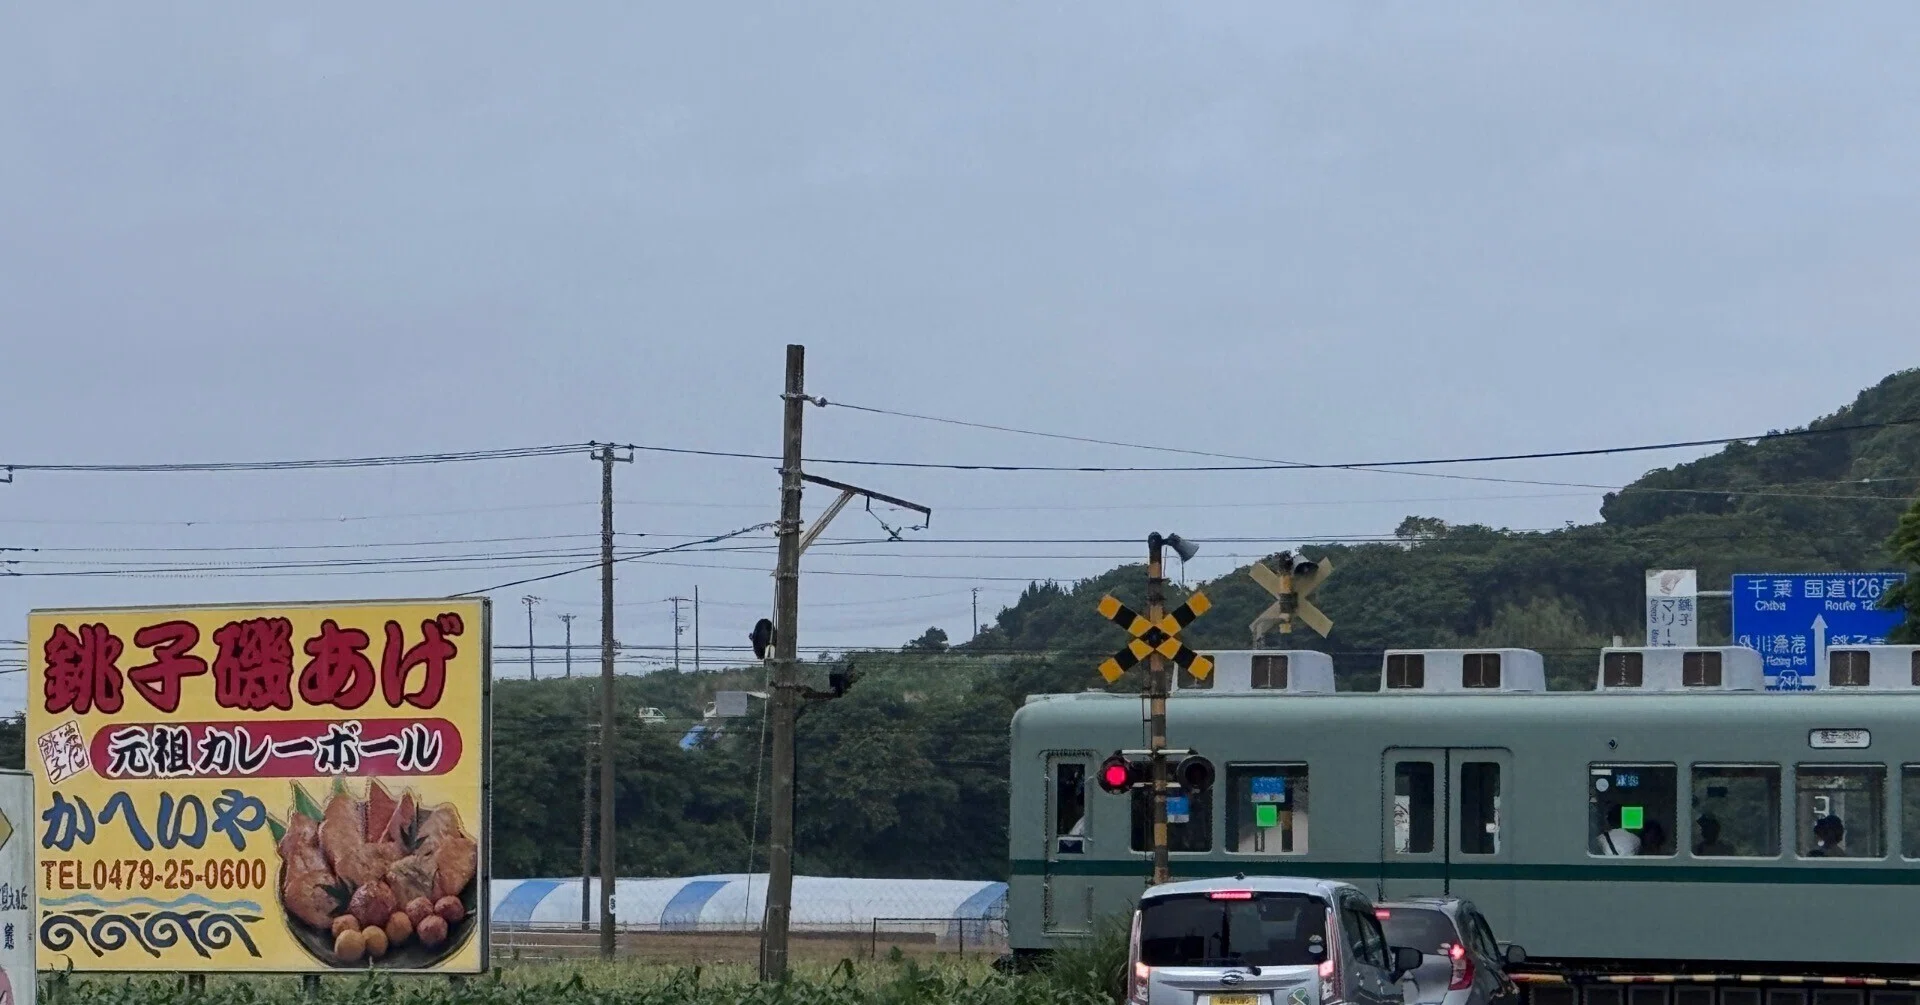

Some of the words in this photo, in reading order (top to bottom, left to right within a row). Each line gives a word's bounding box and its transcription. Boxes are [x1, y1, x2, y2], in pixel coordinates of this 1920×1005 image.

[1747, 578, 1793, 598] 千葉
[1754, 600, 1786, 611] Chiba
[1825, 600, 1856, 611] Route
[44, 612, 464, 714] 銚子磯あげ
[106, 720, 443, 776] 元祖カレーボール
[41, 789, 267, 851] かへいや
[41, 858, 267, 891] TEL0479-25-0600
